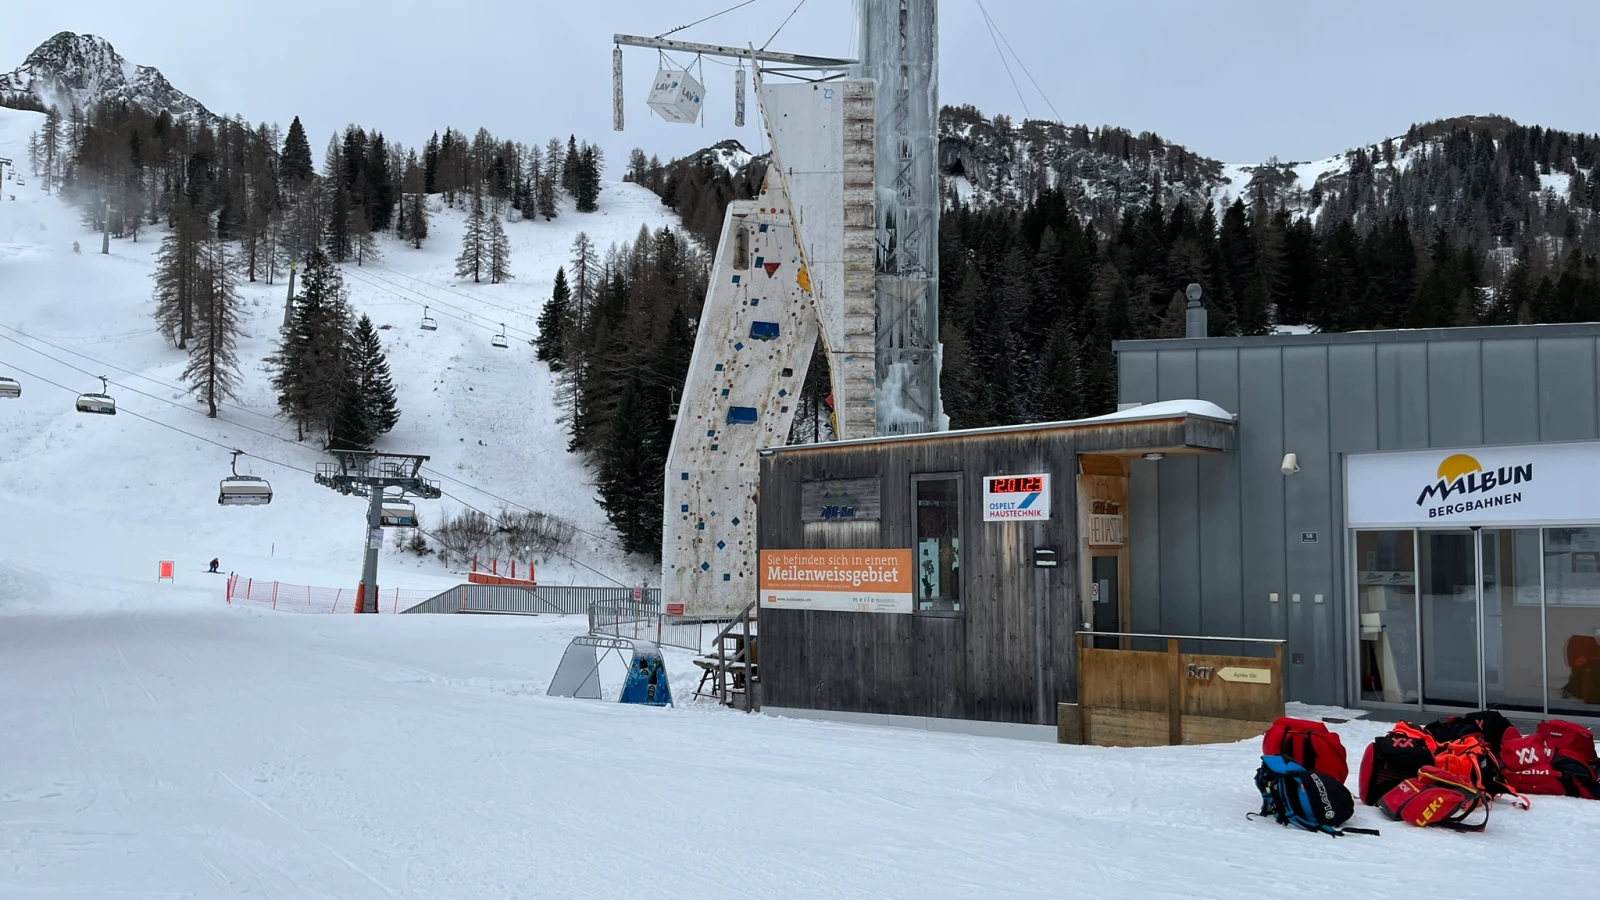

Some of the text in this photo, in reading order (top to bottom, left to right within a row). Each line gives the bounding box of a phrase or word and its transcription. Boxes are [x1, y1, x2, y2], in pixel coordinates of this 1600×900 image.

[655, 82, 671, 91] LAV
[682, 87, 694, 101] LAV
[993, 477, 1043, 493] 12.01.23
[1416, 463, 1533, 507] MALBUN
[989, 502, 1015, 510] OSPELT
[1428, 492, 1522, 518] BERGBAHNEN
[767, 554, 898, 566] Sie befinden sich in einem
[767, 565, 899, 587] Meilenweissgebiet
[1187, 663, 1214, 680] Bar
[1415, 796, 1444, 826] LEKI
